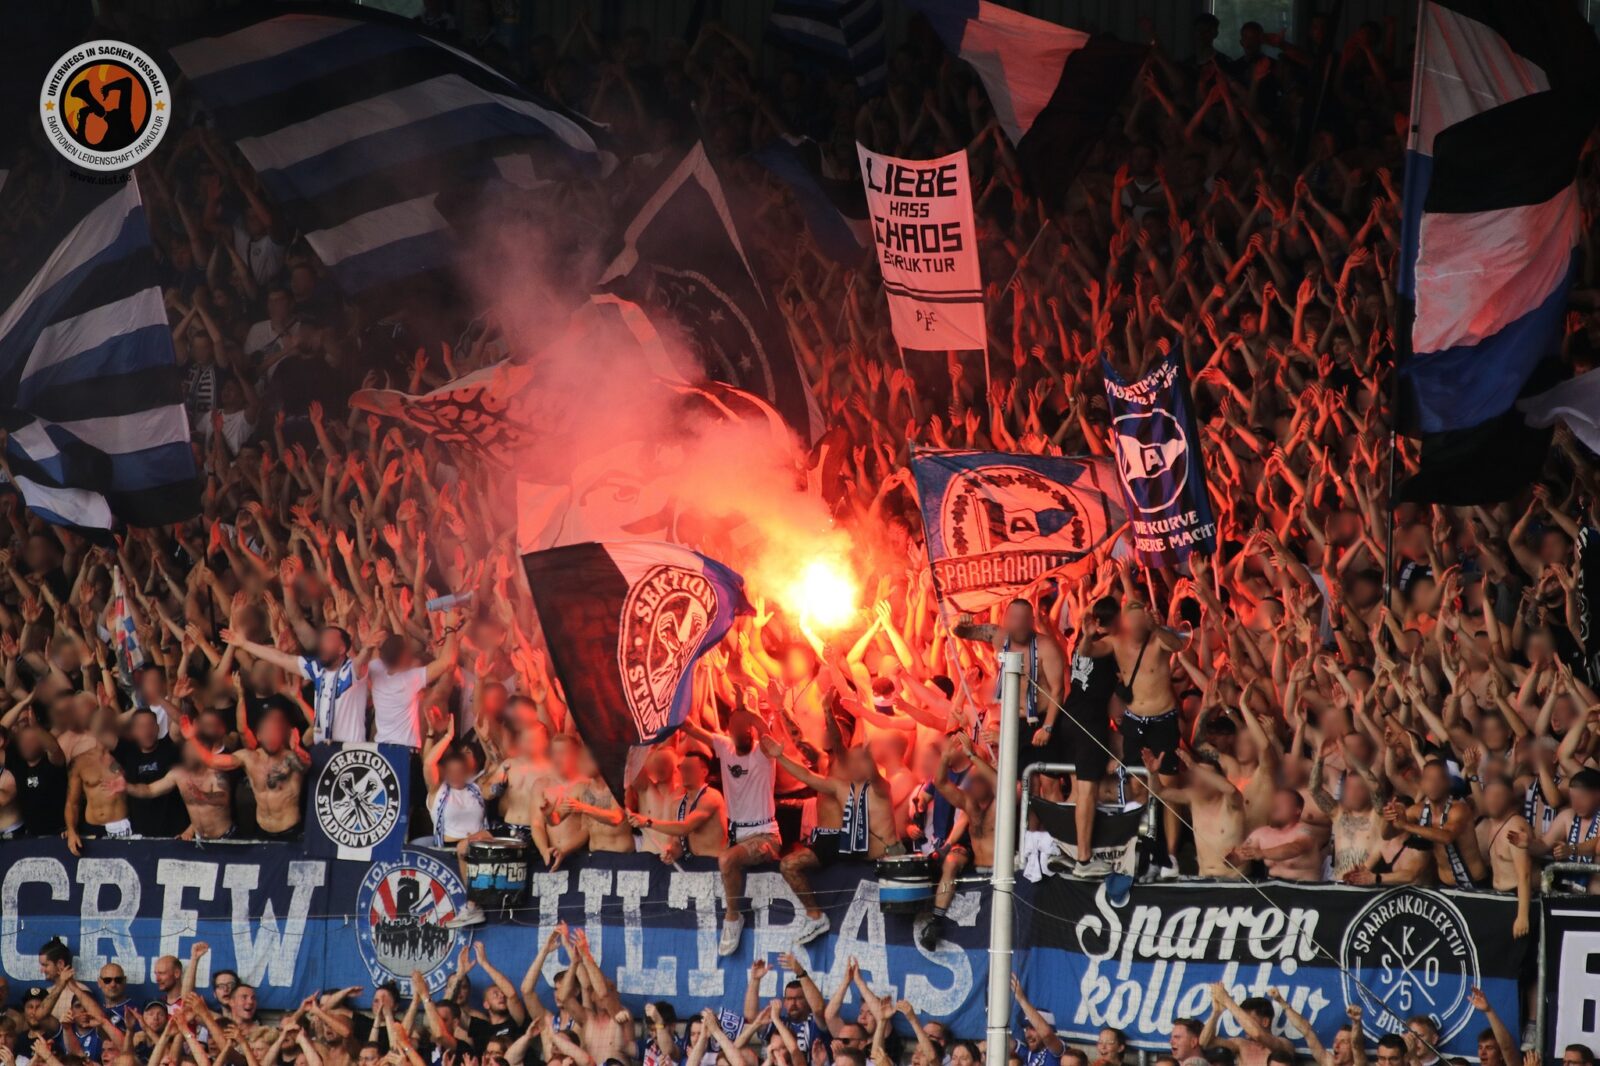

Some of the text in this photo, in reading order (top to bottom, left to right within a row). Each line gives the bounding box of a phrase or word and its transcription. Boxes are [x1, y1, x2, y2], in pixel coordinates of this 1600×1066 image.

[866, 157, 957, 197] LIEBE
[889, 201, 930, 218] HASS
[874, 215, 963, 253] CHAOS
[884, 250, 956, 273] STRUKTUR
[1146, 510, 1199, 535] KURVE
[1168, 522, 1216, 549] MACHT
[634, 570, 716, 623] SEKTION
[330, 751, 391, 780] SEKTION
[317, 795, 399, 848] STADIONVERBOT
[416, 856, 462, 896] CREW
[1, 856, 327, 988] CREW
[1075, 875, 1320, 981] Sparren
[1354, 895, 1466, 957] SPARRENKOLLEKTIV
[1402, 926, 1415, 956] K
[532, 868, 982, 1017] ULTRAS
[1381, 954, 1393, 984] S
[1400, 981, 1412, 1011] 5
